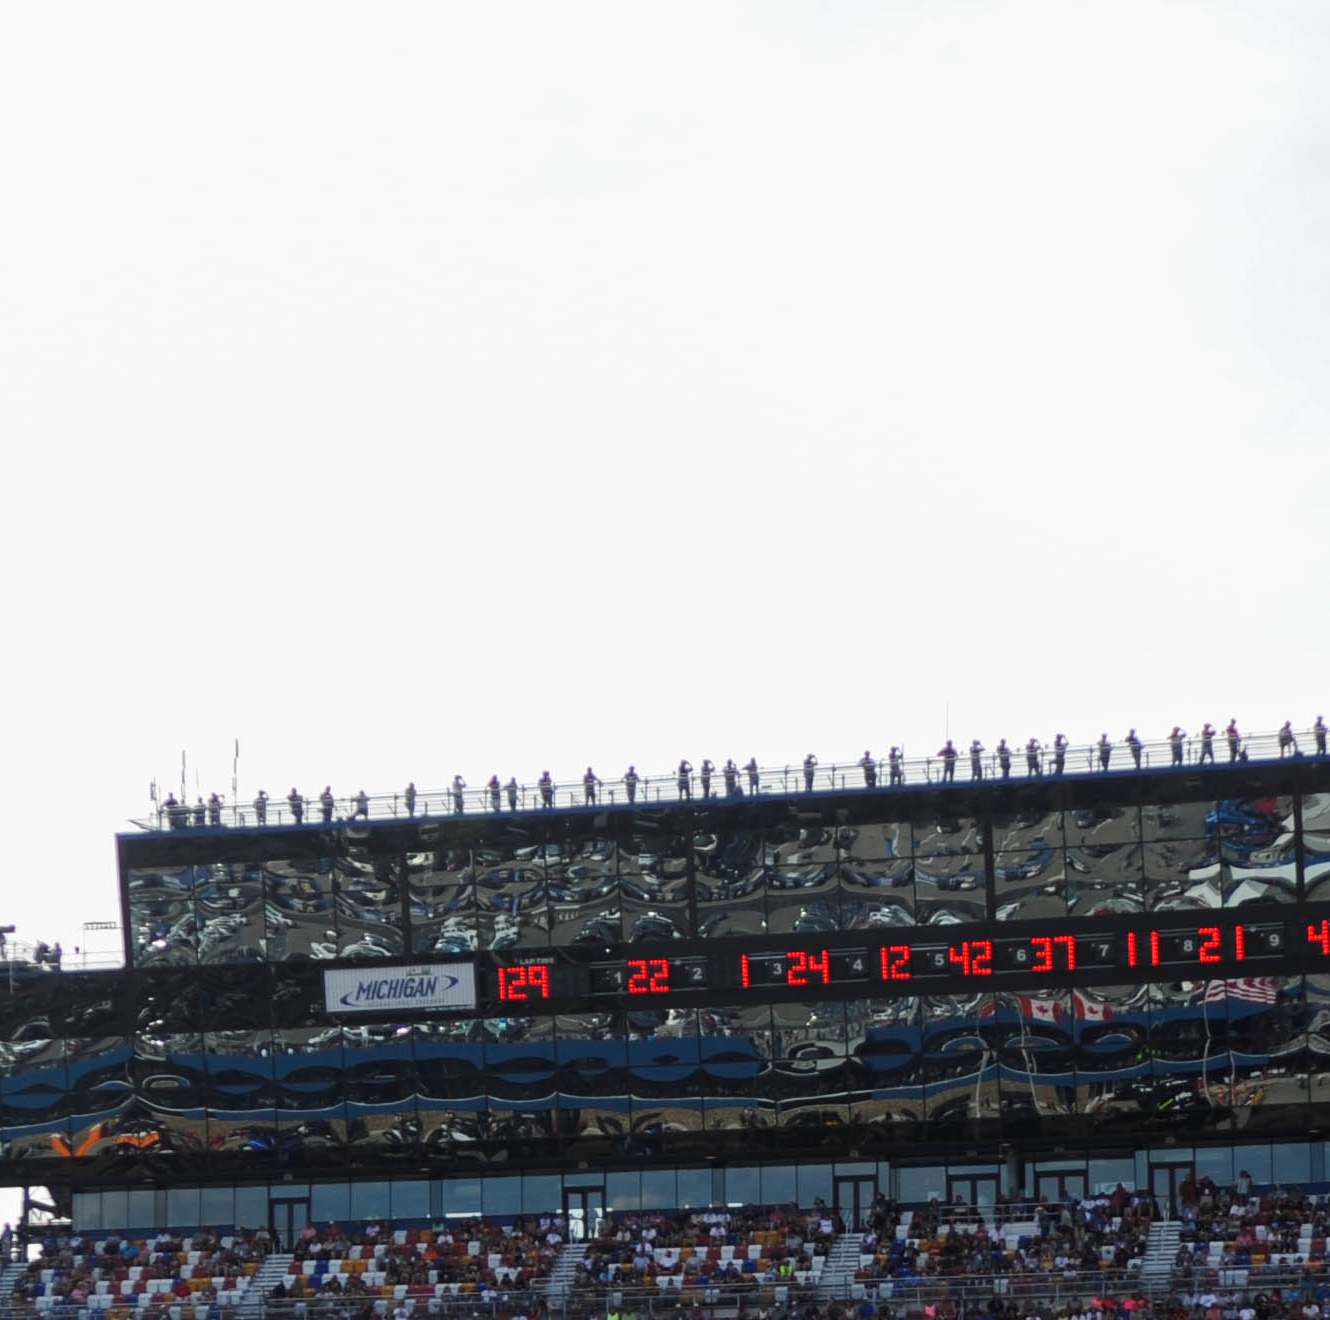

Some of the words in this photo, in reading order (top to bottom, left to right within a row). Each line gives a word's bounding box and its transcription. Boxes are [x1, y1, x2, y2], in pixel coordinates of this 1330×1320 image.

[1016, 949, 1026, 962] 6
[1031, 935, 1076, 972] 37
[1099, 945, 1109, 957] 7
[1127, 930, 1159, 967] 11
[1184, 940, 1193, 952] 8
[1197, 925, 1245, 963] 21
[1270, 934, 1279, 946] 9
[1307, 919, 1330, 955] 4
[692, 967, 702, 979] 2
[741, 953, 749, 988] 1
[773, 963, 782, 975] 3
[786, 949, 830, 985] 24
[852, 959, 863, 971] 4
[880, 944, 912, 980] 12
[934, 953, 944, 966] 5
[949, 938, 993, 976] 42
[356, 976, 438, 1000] MICHIGAN
[614, 971, 622, 983] 1
[627, 959, 669, 994] 22
